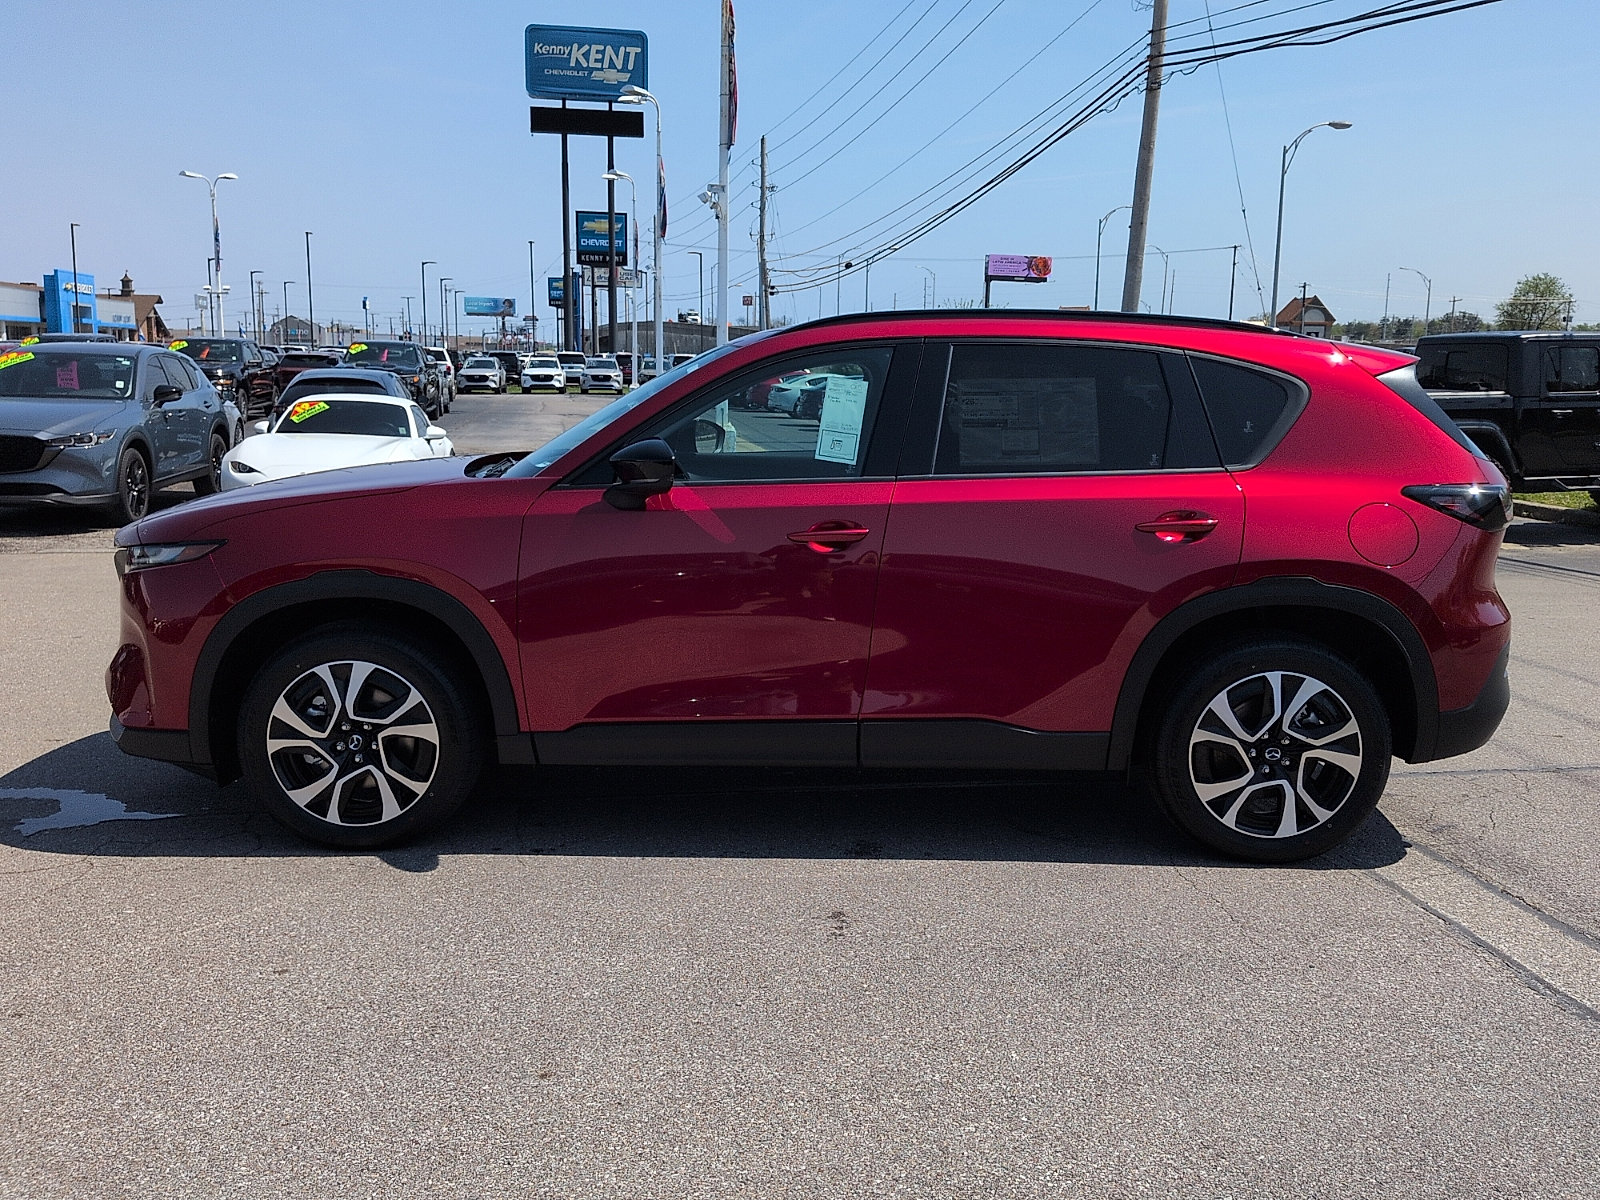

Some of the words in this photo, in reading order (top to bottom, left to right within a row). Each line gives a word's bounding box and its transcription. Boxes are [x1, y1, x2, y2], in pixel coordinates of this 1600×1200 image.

[534, 42, 571, 58] Kenny
[569, 43, 641, 71] KENT
[544, 69, 589, 77] CHEVROLET
[581, 238, 623, 247] CHEVROET
[581, 254, 604, 262] KENNY
